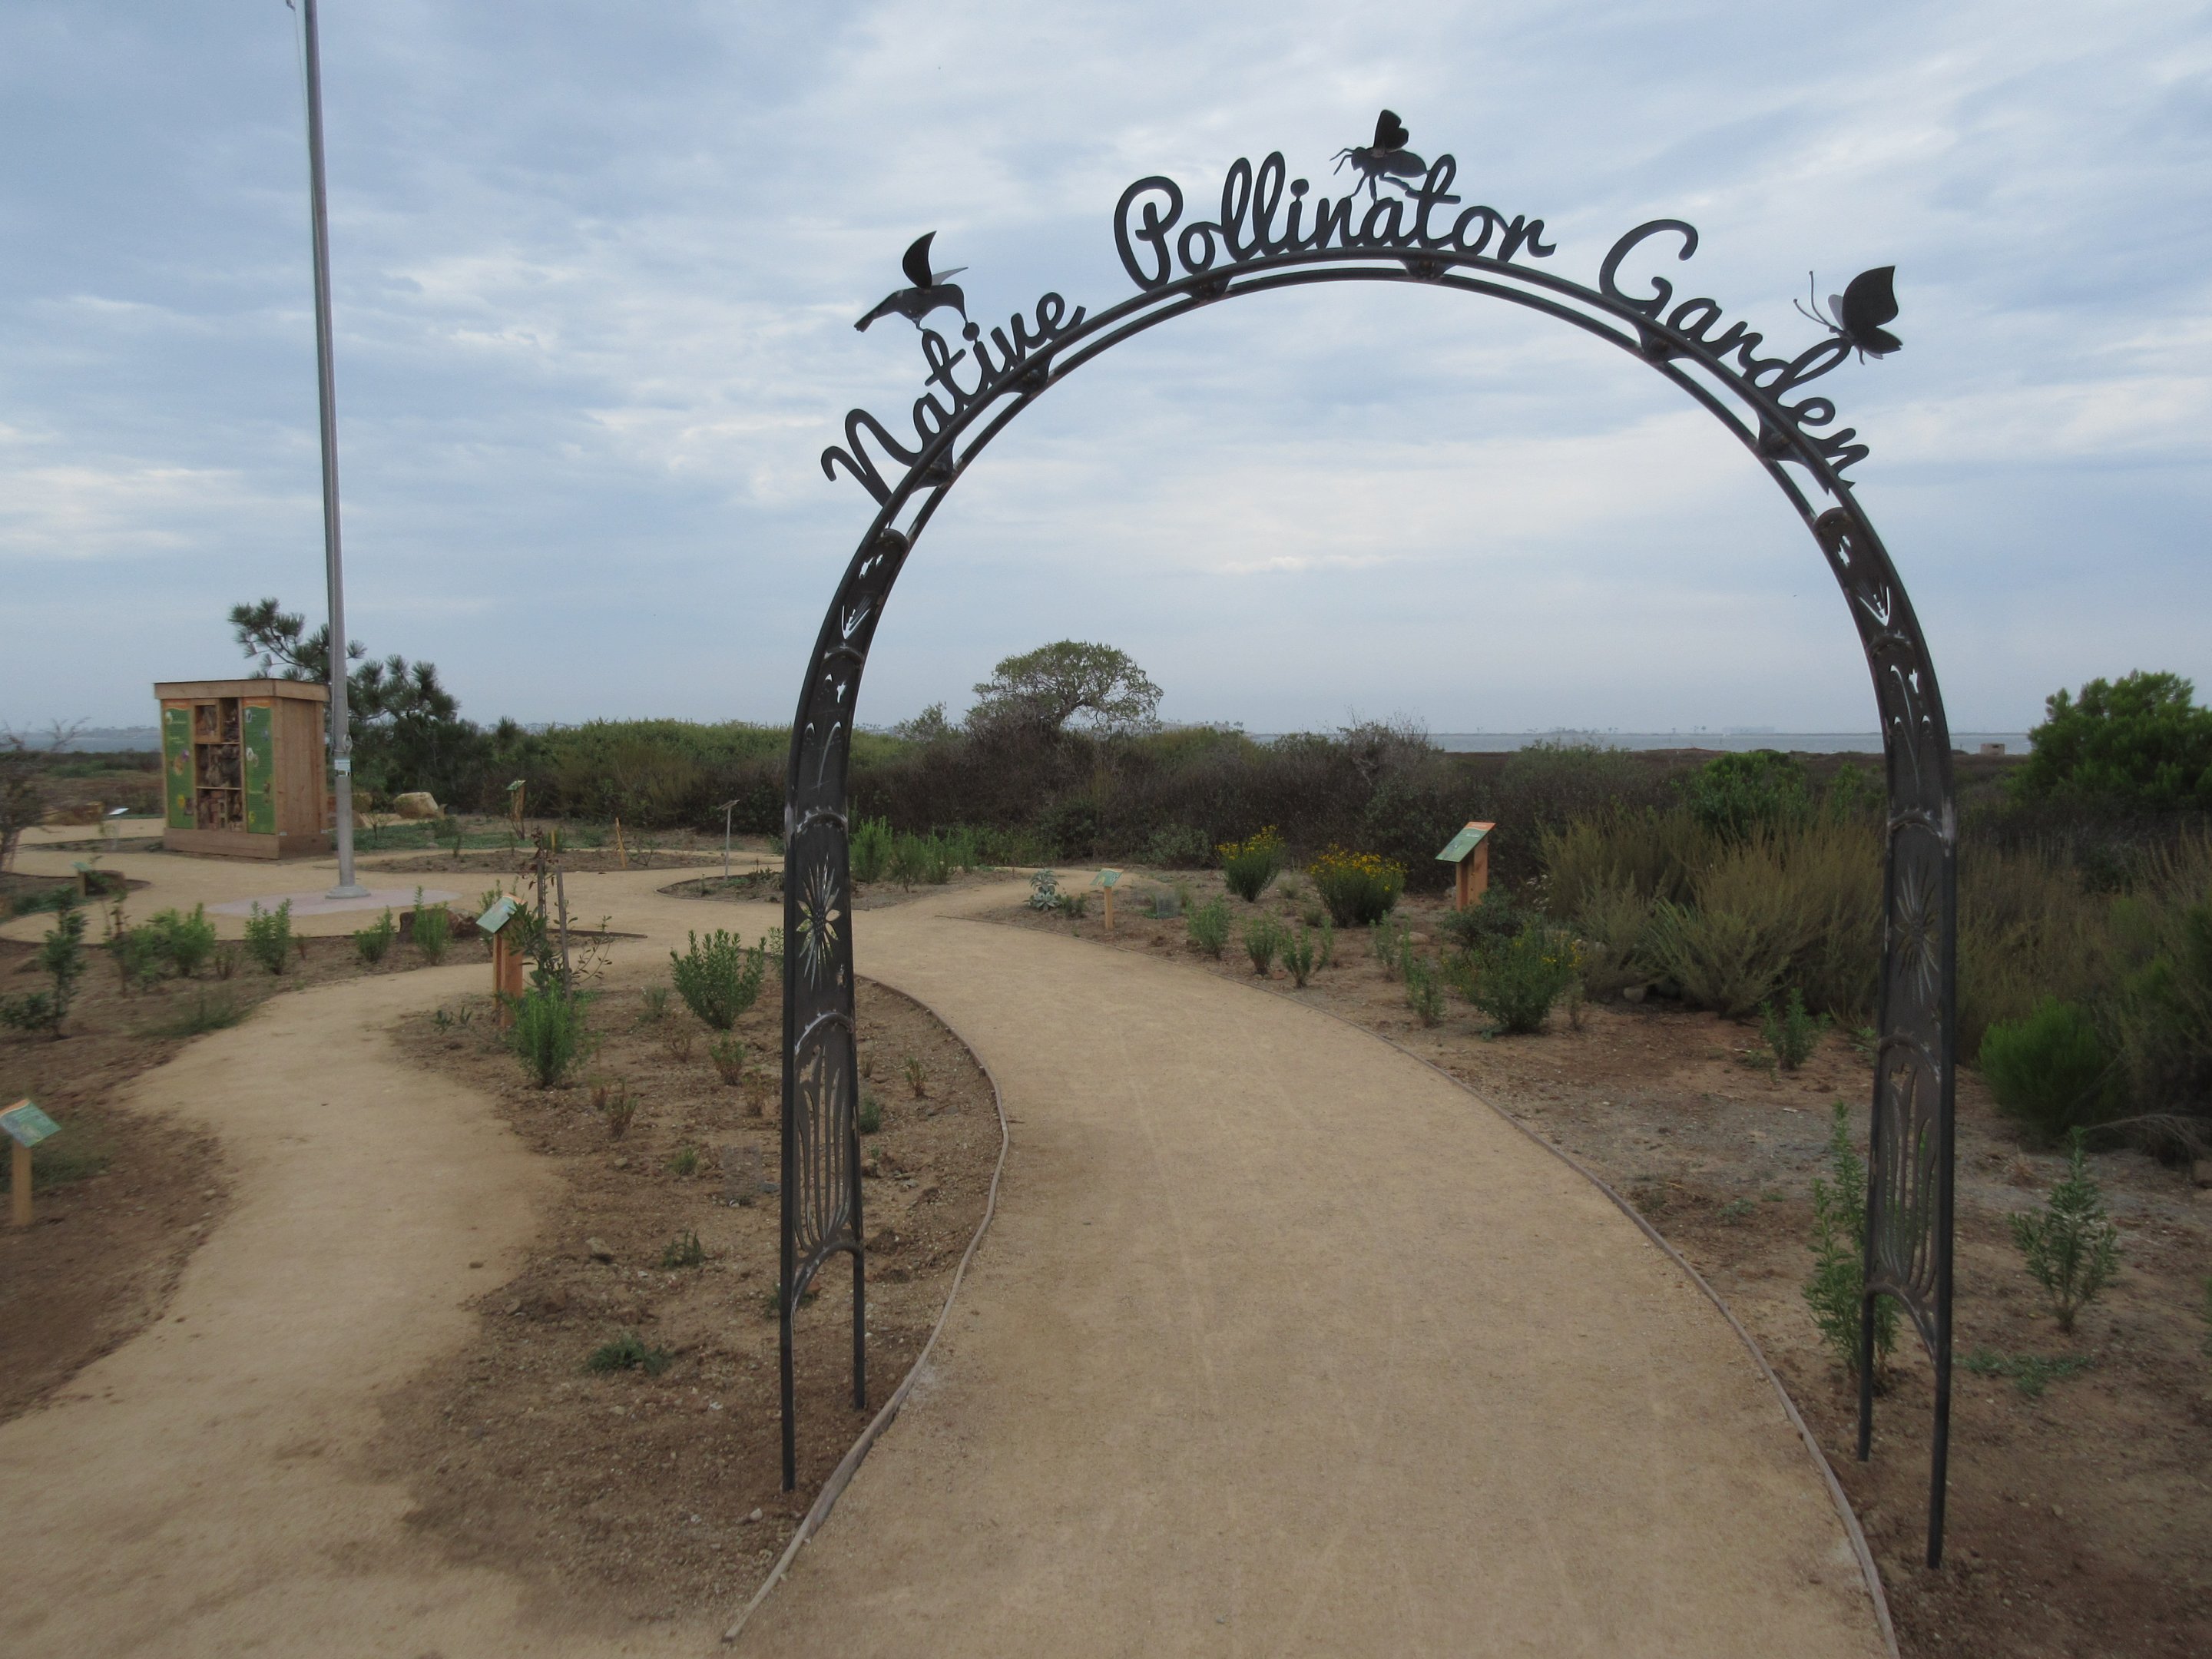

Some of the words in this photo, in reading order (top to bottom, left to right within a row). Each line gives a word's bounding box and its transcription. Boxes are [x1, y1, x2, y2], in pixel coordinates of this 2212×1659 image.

[820, 292, 1086, 507] Native
[1114, 151, 1557, 292] Pollinator
[1599, 219, 1869, 489] Garden
